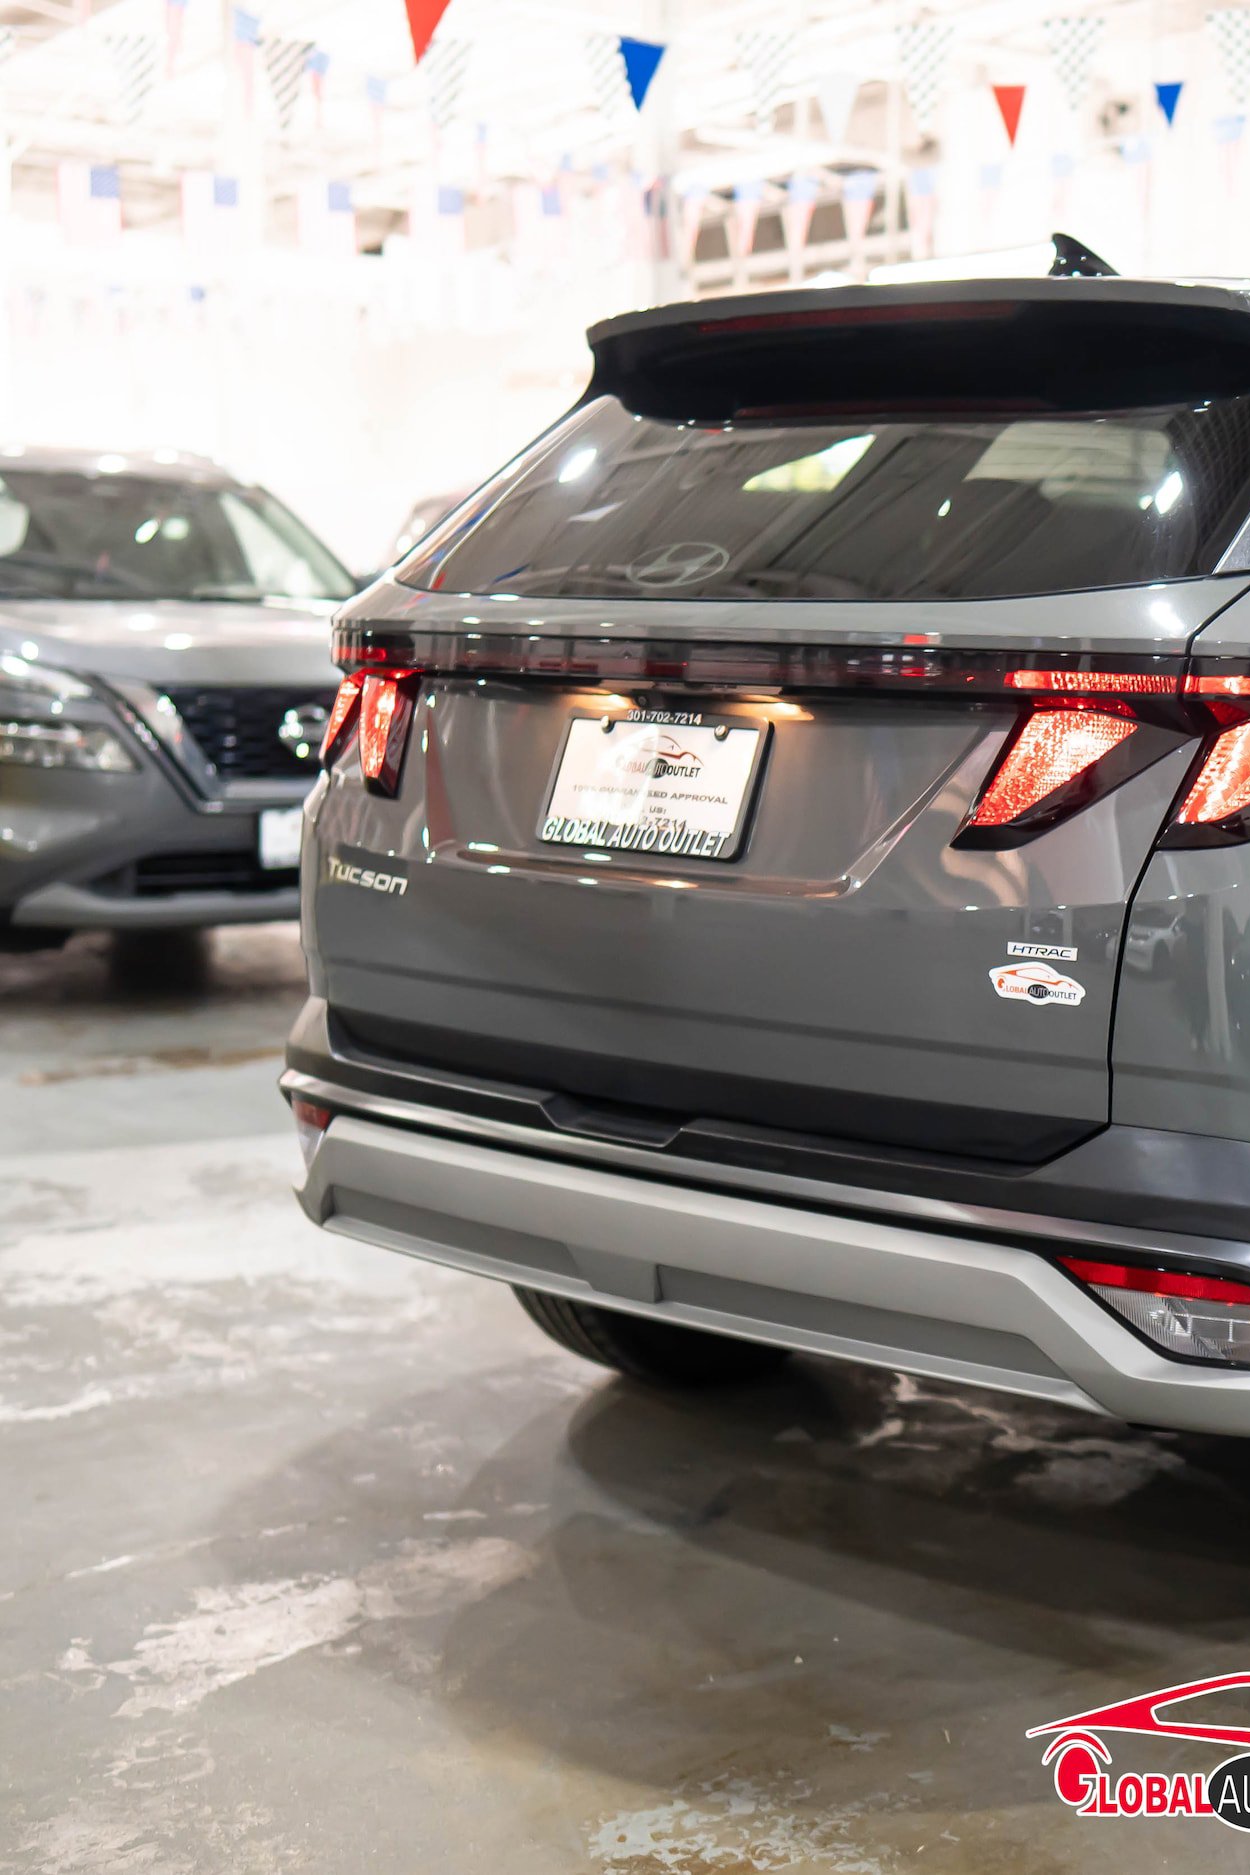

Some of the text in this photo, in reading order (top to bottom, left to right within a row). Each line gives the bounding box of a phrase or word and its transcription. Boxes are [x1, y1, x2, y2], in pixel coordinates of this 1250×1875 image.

[627, 710, 702, 726] 301-702-7214
[669, 792, 728, 805] APPROVAL
[542, 816, 730, 857] GLOBAL AUTO OUTLET
[1012, 945, 1072, 958] HTRAC
